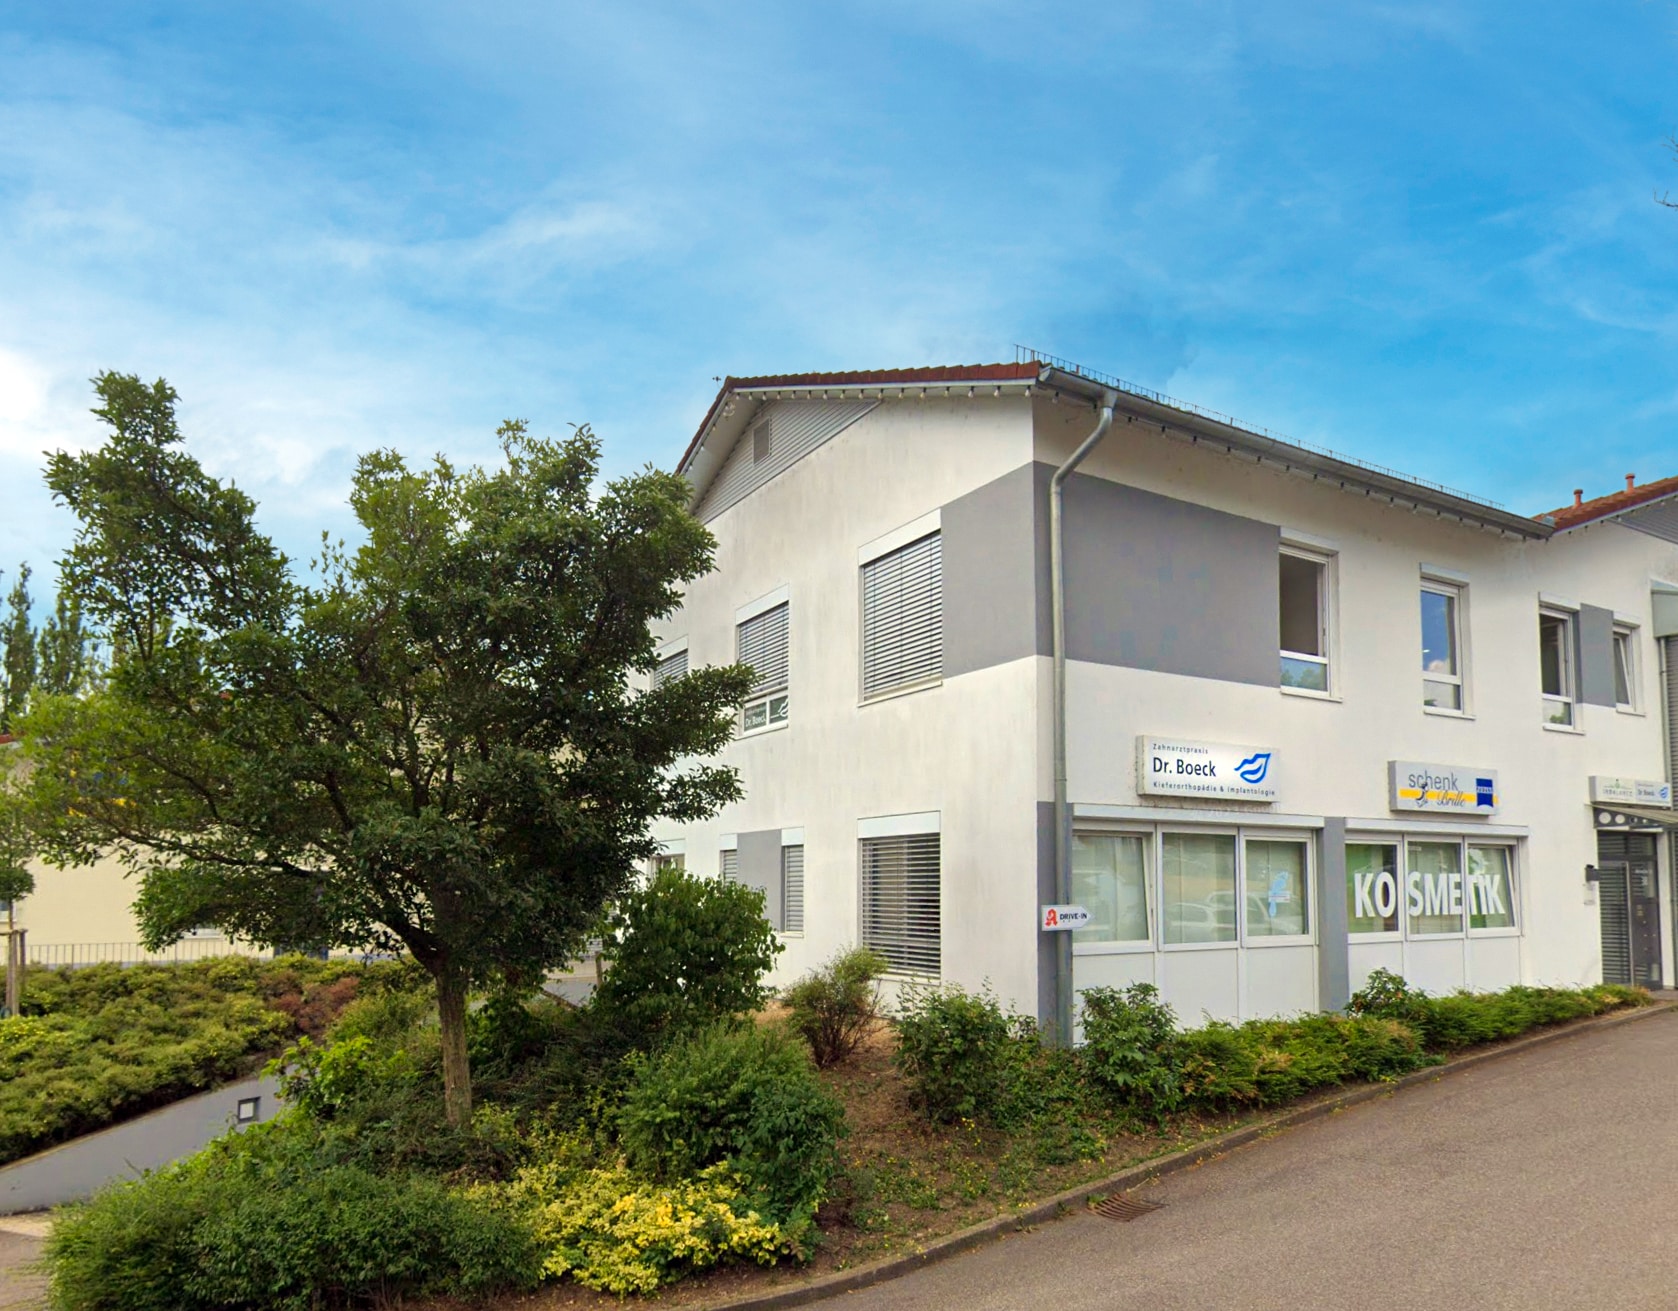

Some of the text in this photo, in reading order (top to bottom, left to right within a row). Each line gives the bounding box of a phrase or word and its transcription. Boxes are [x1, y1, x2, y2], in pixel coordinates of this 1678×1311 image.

[1153, 743, 1209, 754] Zahnarztpraxis
[1153, 757, 1217, 777] Dr. Boeck
[1153, 782, 1217, 792] Kieferorthopädie
[1408, 769, 1458, 791] schenk
[1353, 871, 1506, 918] KOSMETIK
[1059, 912, 1088, 920] DRIVE-IN
